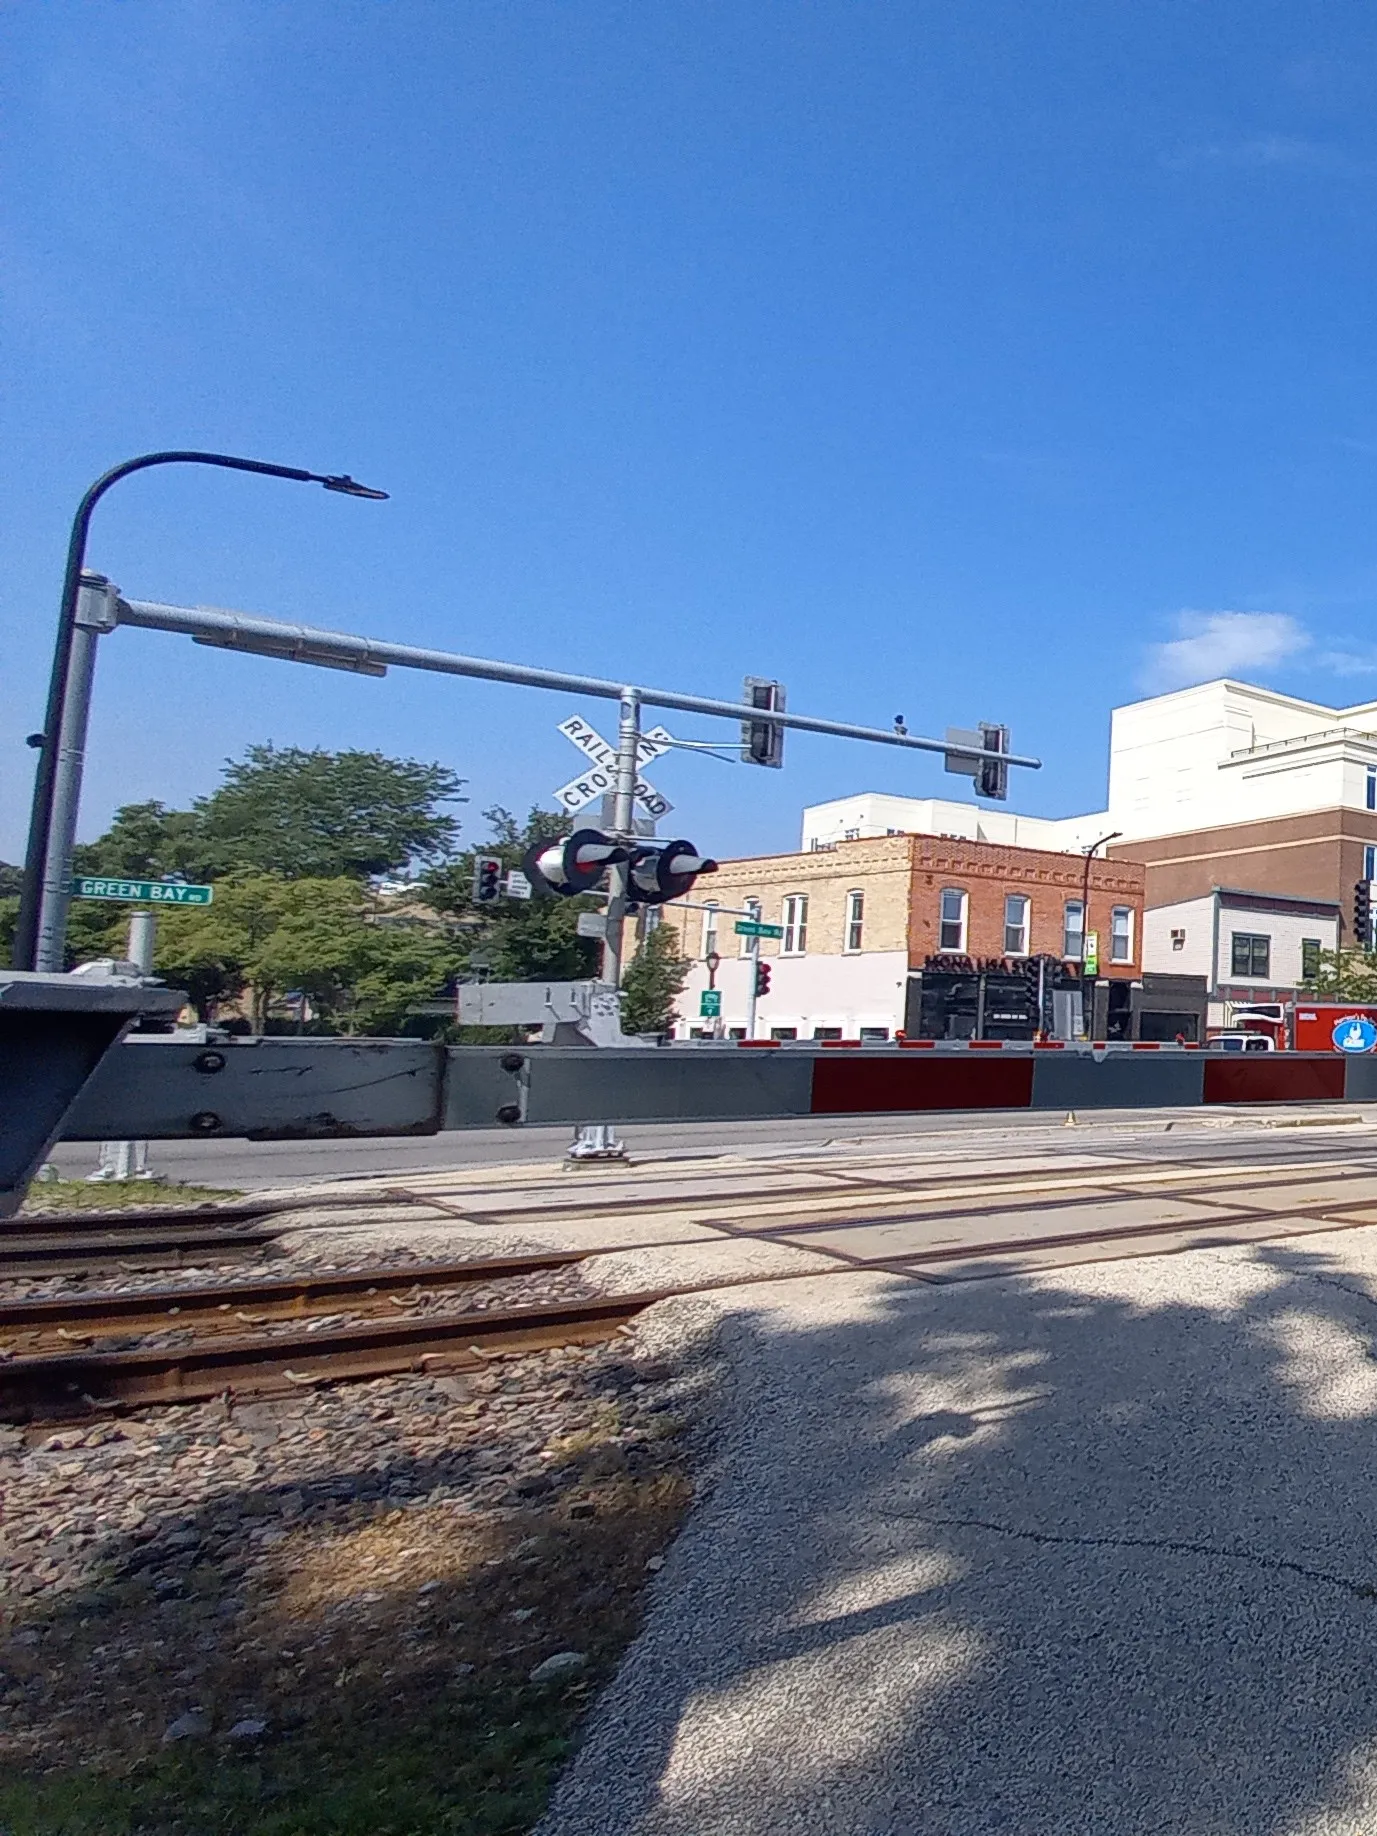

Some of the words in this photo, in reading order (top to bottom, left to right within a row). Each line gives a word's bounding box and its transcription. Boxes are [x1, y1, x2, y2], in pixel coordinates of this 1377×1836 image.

[564, 720, 666, 815] RAILOAD
[81, 880, 142, 898] GREEN
[150, 885, 188, 900] BAY
